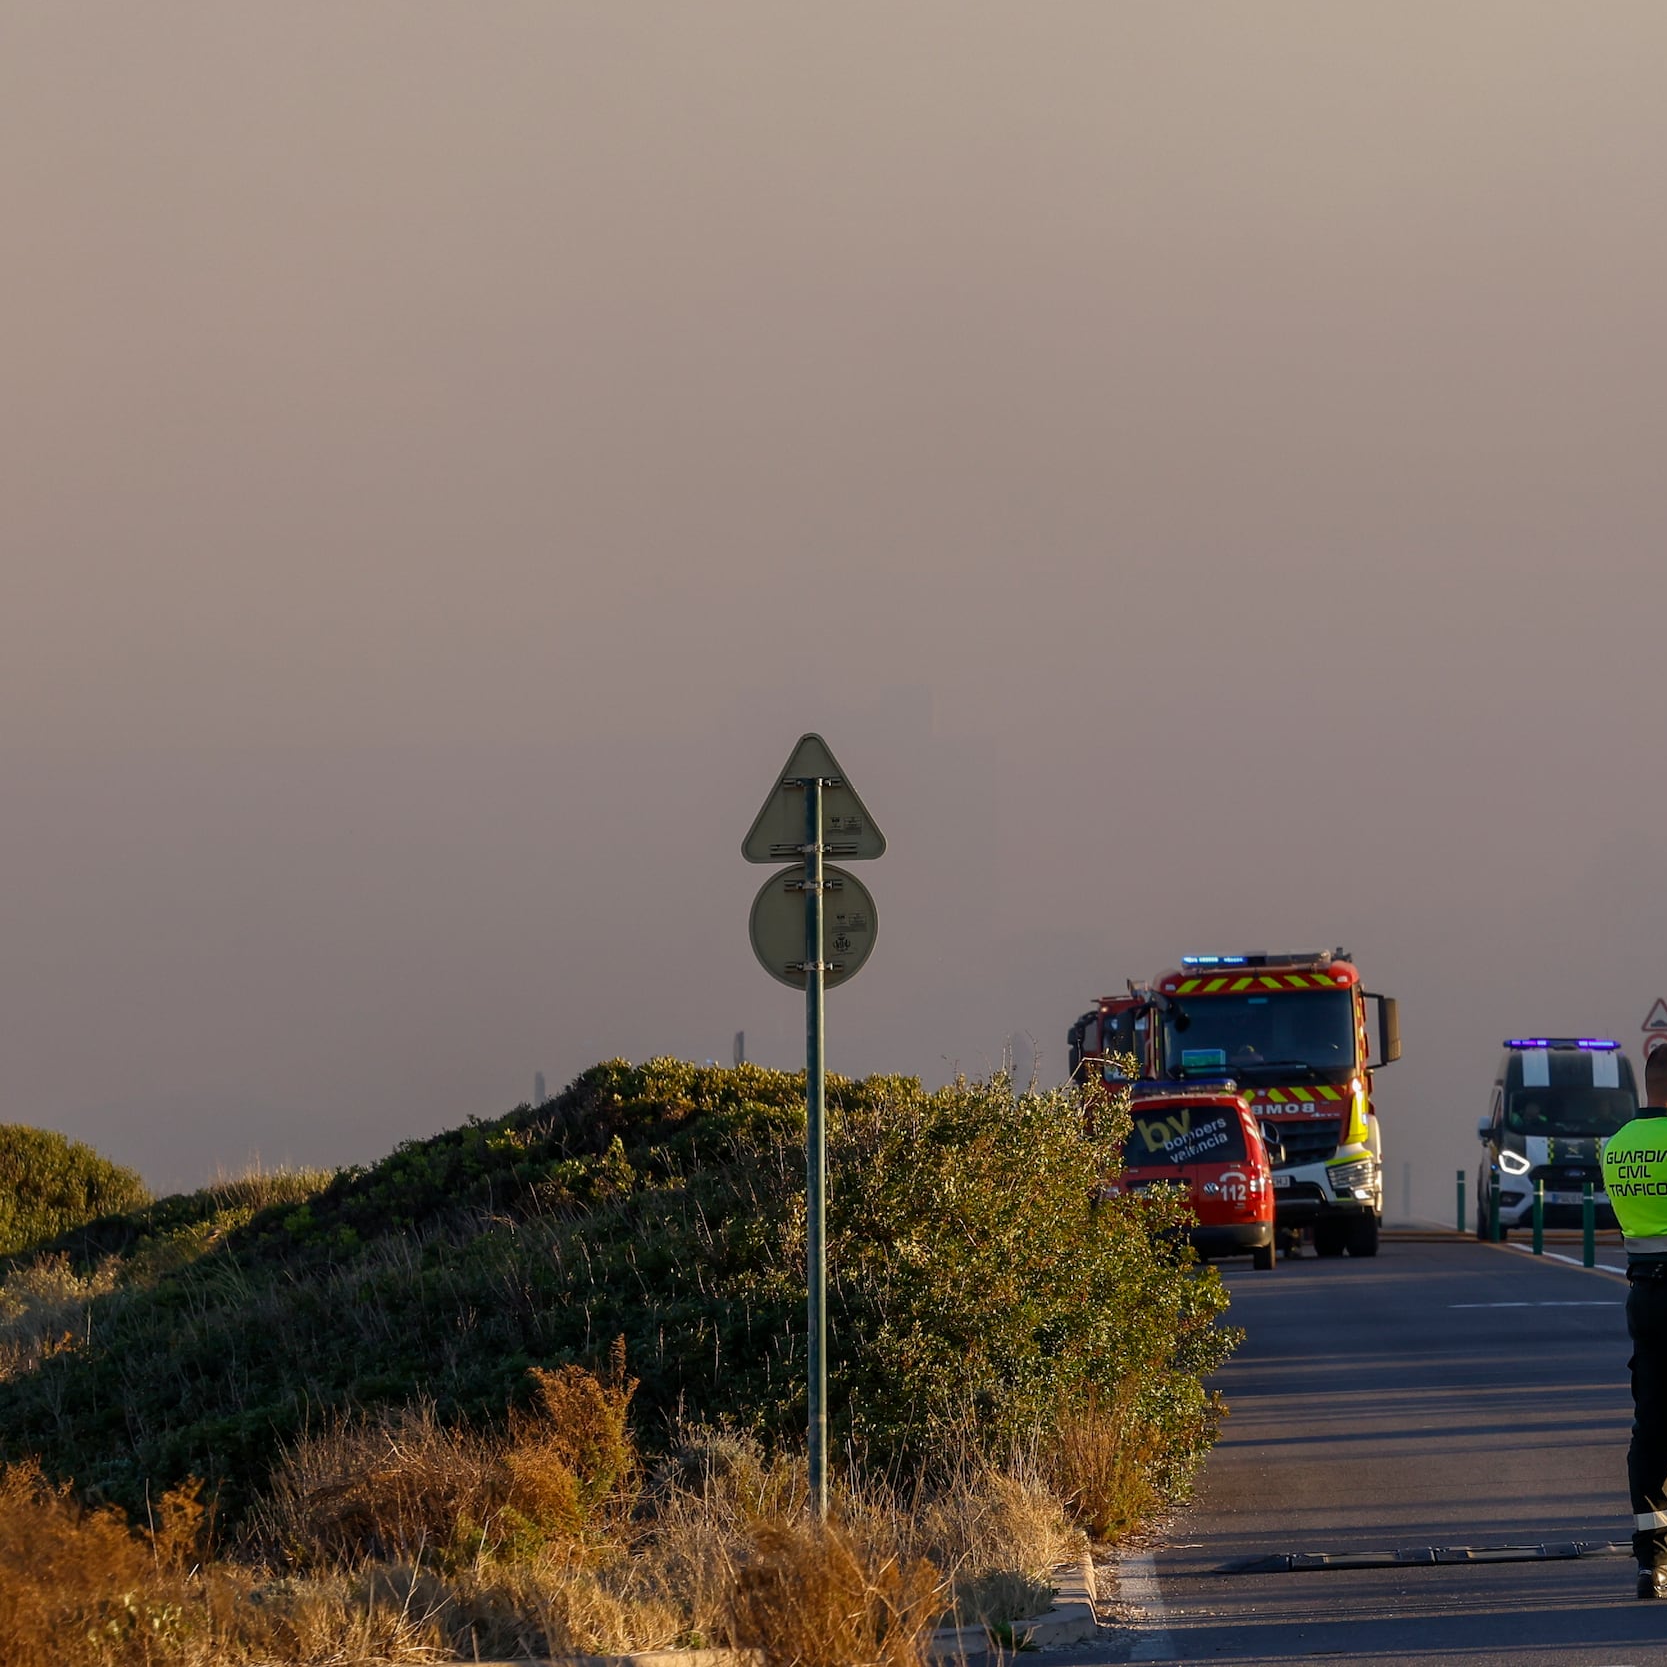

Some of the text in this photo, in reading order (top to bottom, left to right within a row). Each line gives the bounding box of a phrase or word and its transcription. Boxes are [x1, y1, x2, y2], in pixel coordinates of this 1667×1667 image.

[1136, 1108, 1190, 1153] bv
[1163, 1117, 1228, 1152] bombers
[1617, 1164, 1652, 1180] CIVIL
[1220, 1183, 1247, 1202] 112
